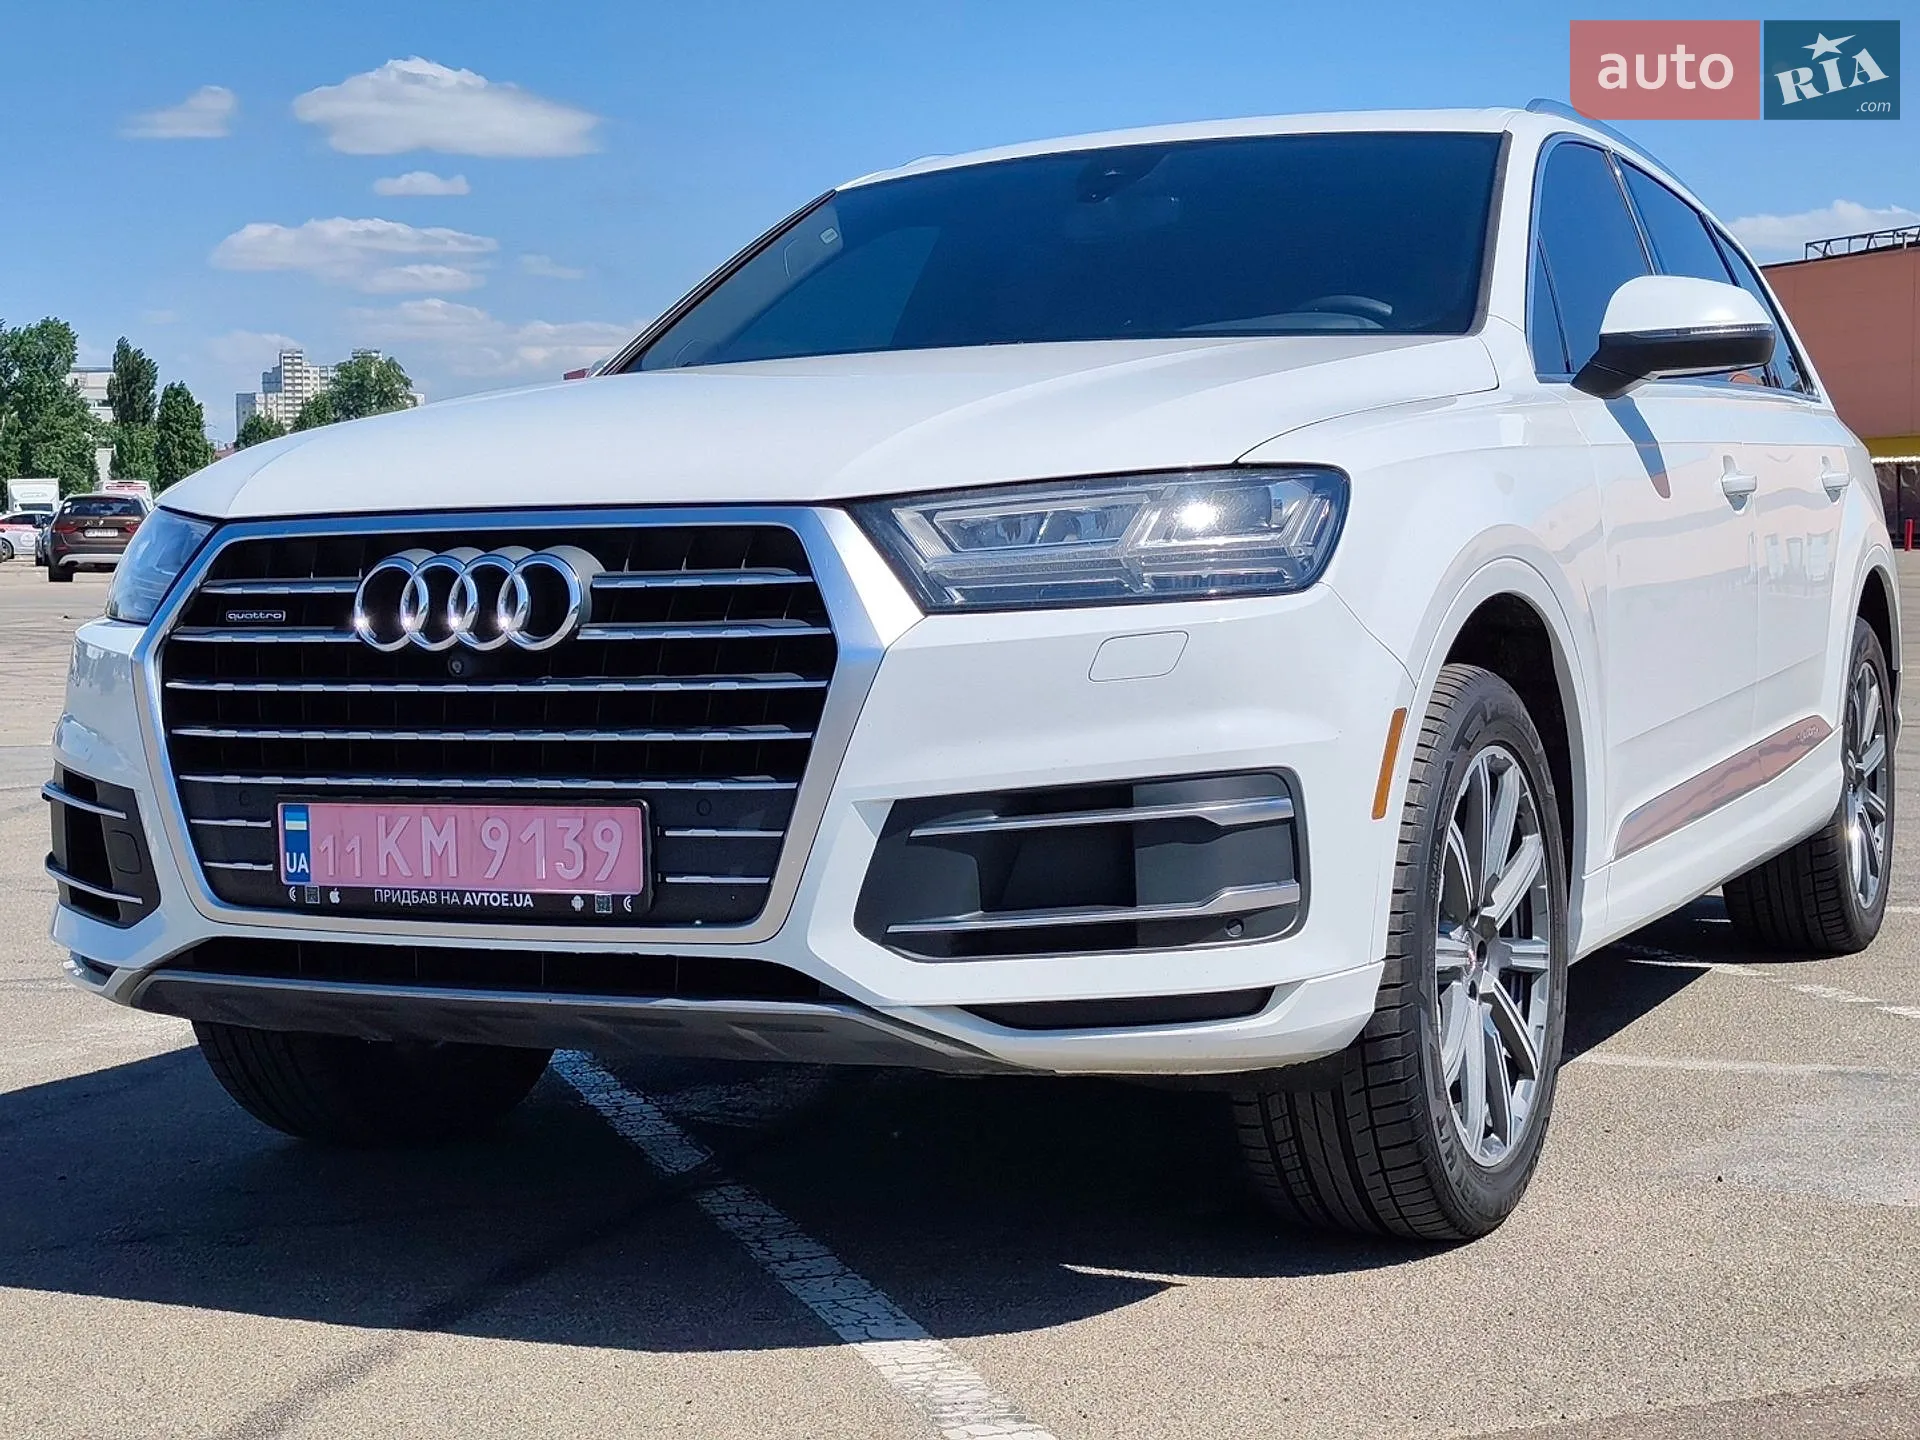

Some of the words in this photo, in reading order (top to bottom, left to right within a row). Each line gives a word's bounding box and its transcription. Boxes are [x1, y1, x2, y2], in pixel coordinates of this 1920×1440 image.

[227, 612, 282, 621] quattro
[318, 834, 363, 878] 11
[480, 816, 624, 882] 9139
[285, 851, 310, 874] UA
[374, 889, 437, 906] ПРИДБАВ
[441, 891, 461, 905] НА
[463, 892, 534, 908] AVTOE.UA
